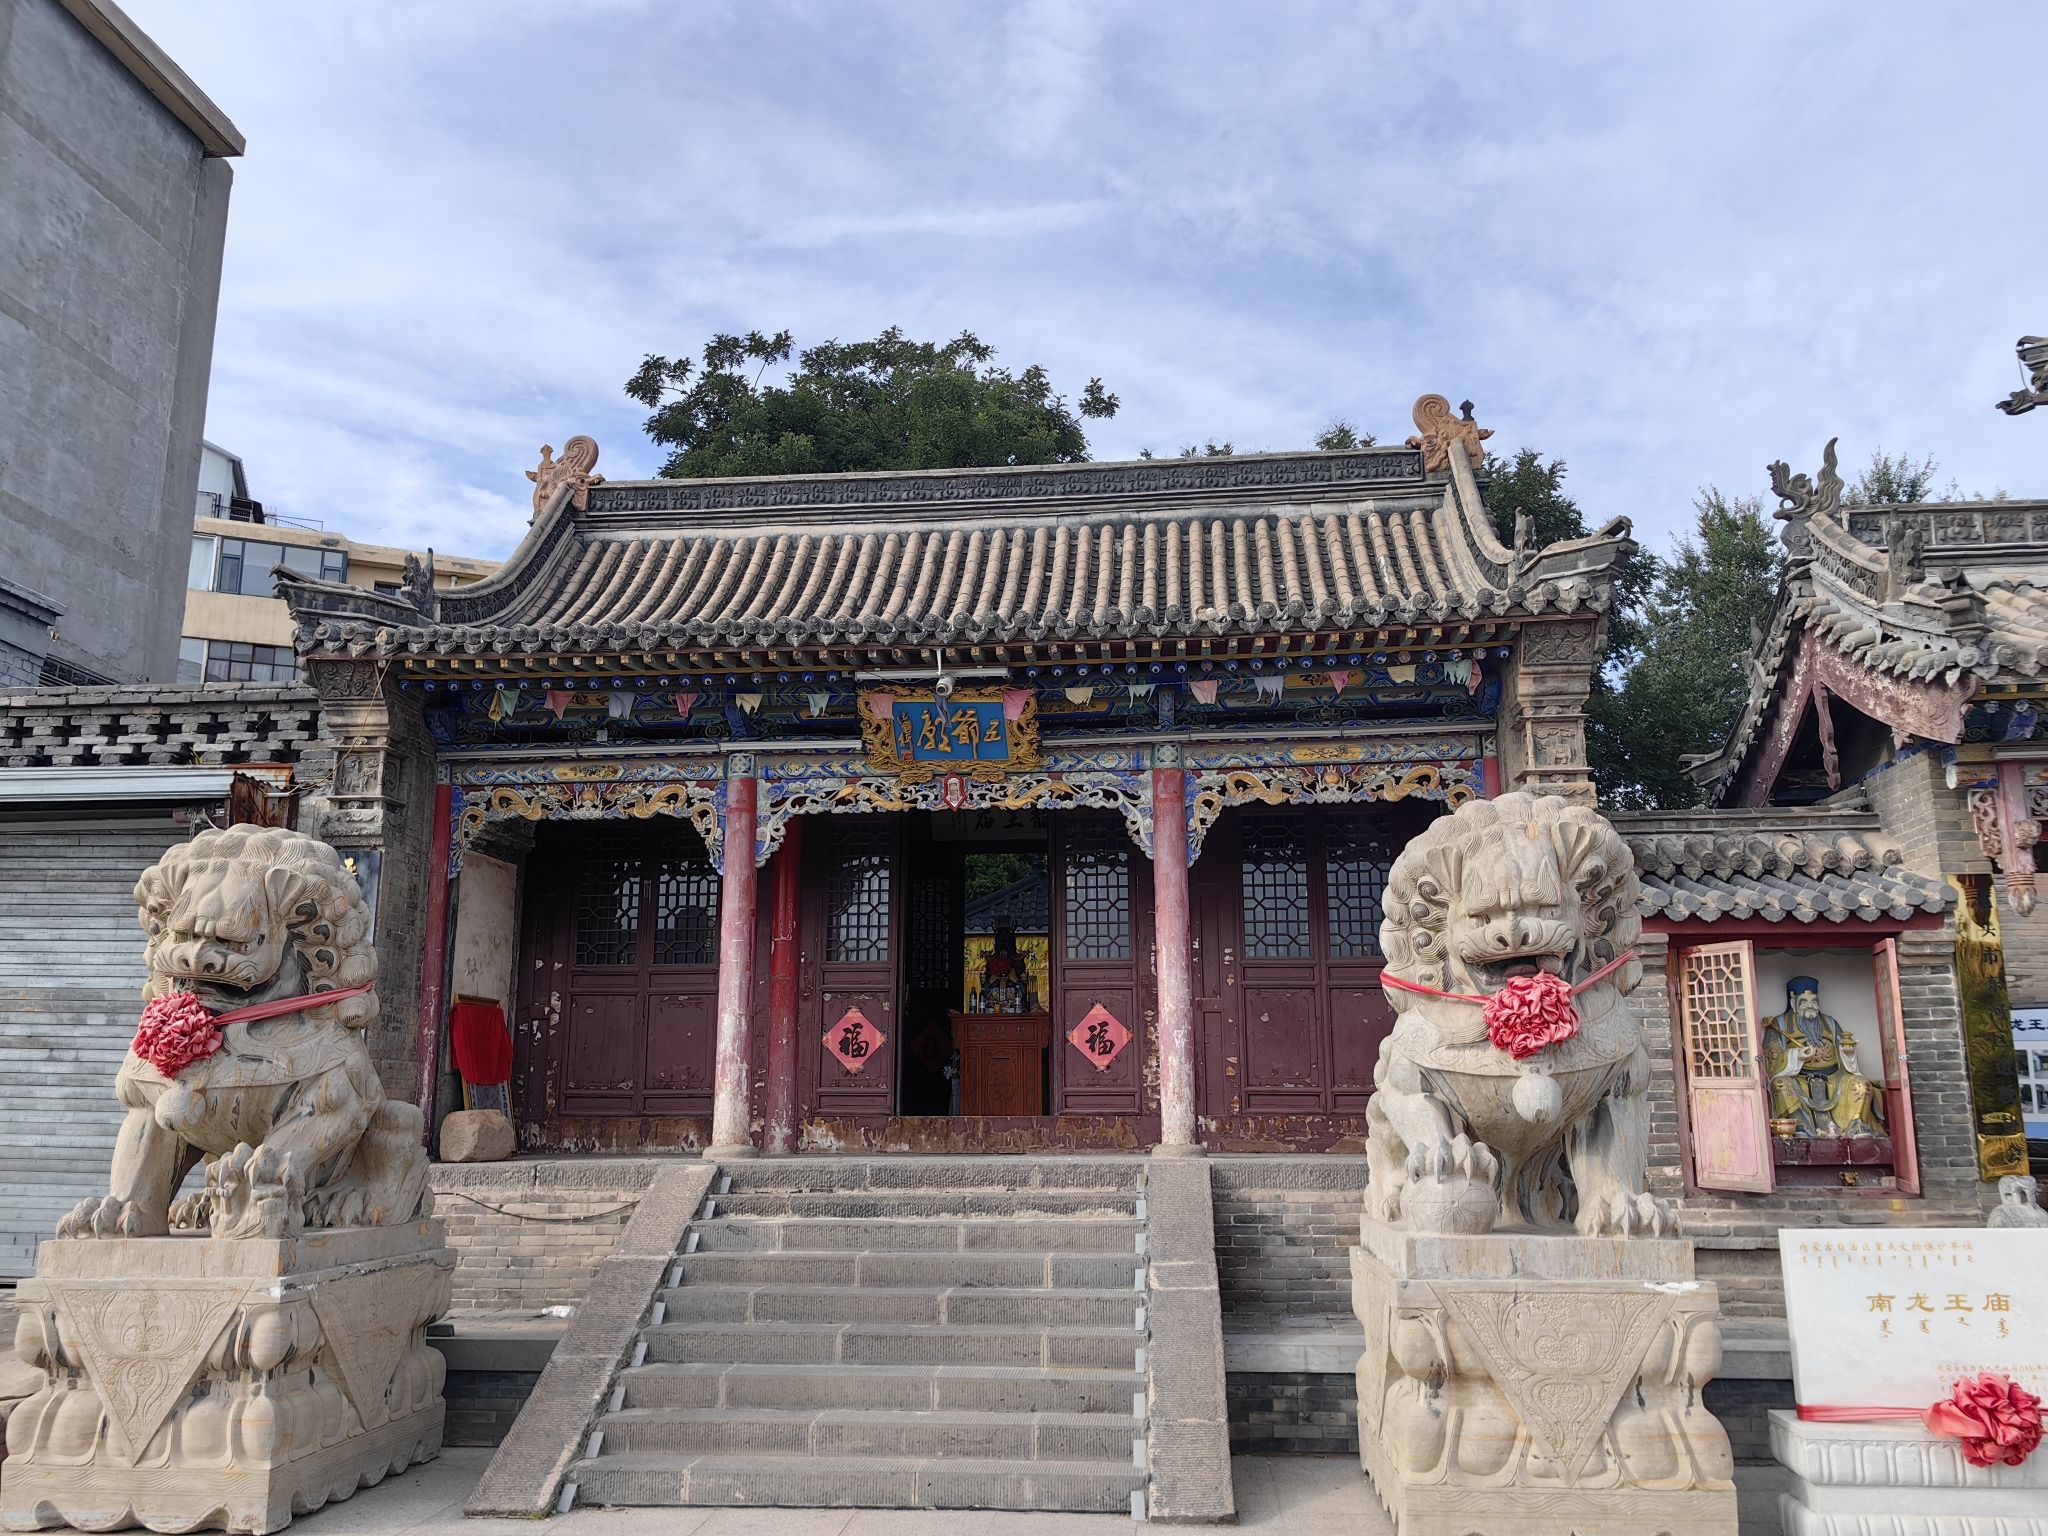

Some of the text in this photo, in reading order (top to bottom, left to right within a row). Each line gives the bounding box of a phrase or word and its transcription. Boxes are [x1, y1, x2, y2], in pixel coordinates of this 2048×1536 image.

[1085, 1020, 1116, 1056] 福
[2010, 1018, 2048, 1032] 龙王
[838, 1022, 870, 1058] 福
[1866, 1291, 2012, 1313] 南龙王庙
